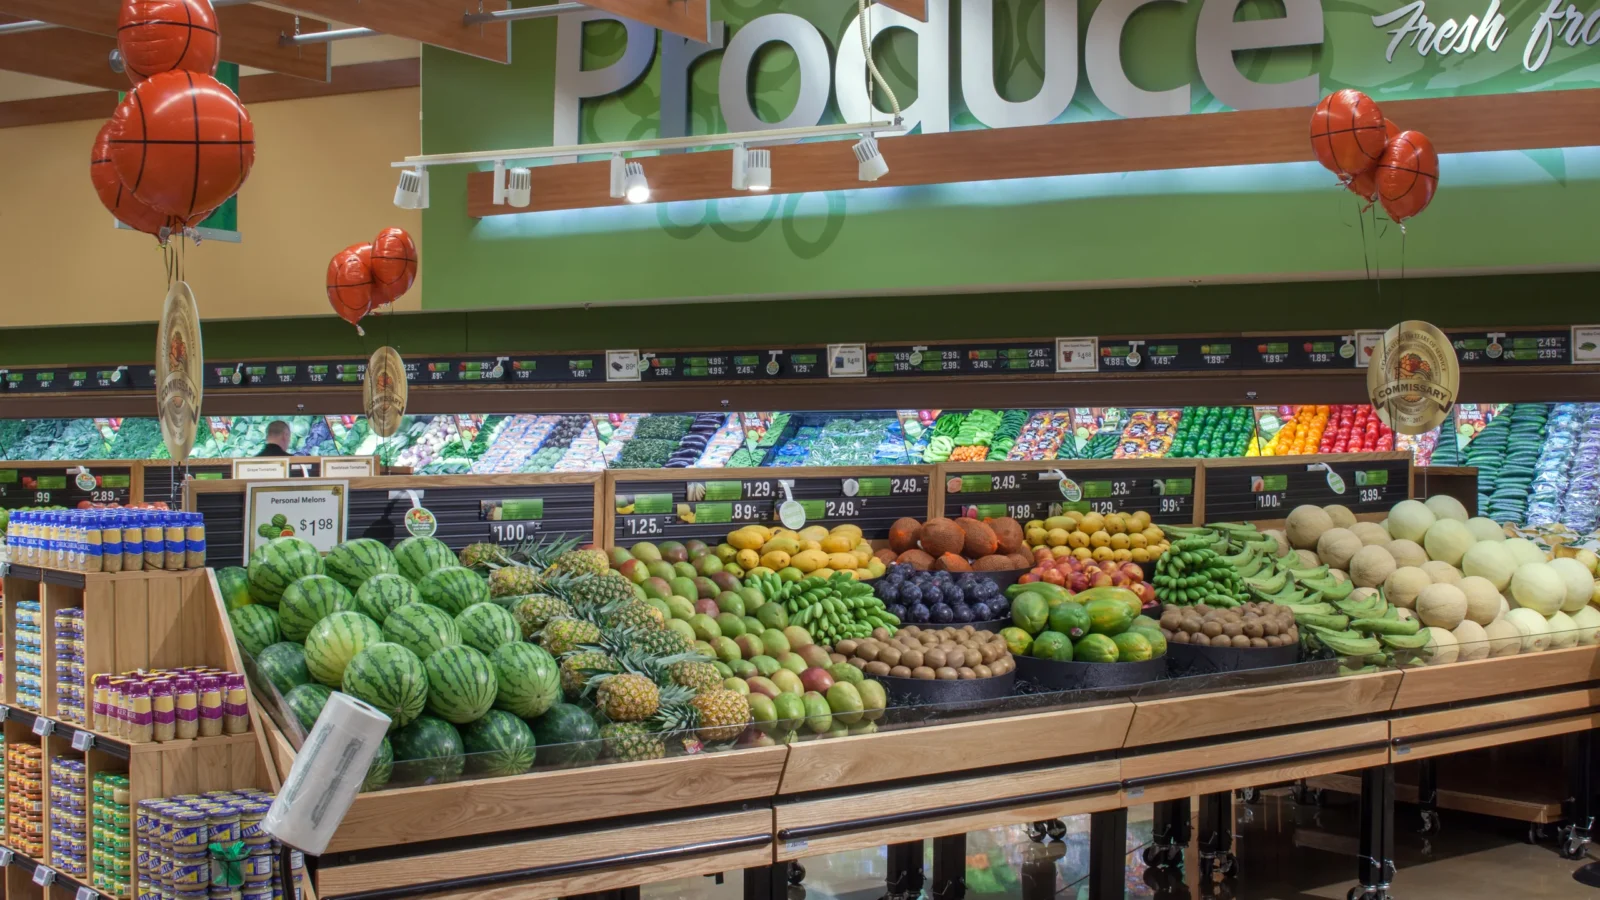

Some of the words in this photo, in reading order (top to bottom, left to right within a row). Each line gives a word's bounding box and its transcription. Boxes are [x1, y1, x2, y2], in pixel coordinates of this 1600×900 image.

[1371, 0, 1508, 63] Fresh
[553, 0, 1324, 165] Produce
[1378, 383, 1447, 401] COMMISSARY
[743, 481, 770, 497] $1.29
[891, 478, 916, 493] $2.49
[991, 475, 1016, 490] $3.49
[91, 490, 114, 502] $2.89
[1360, 488, 1378, 502] $3.99
[826, 501, 854, 516] $2.49
[1008, 504, 1030, 519] $1.98
[493, 524, 524, 541] $1.00
[627, 518, 656, 534] $1.25
